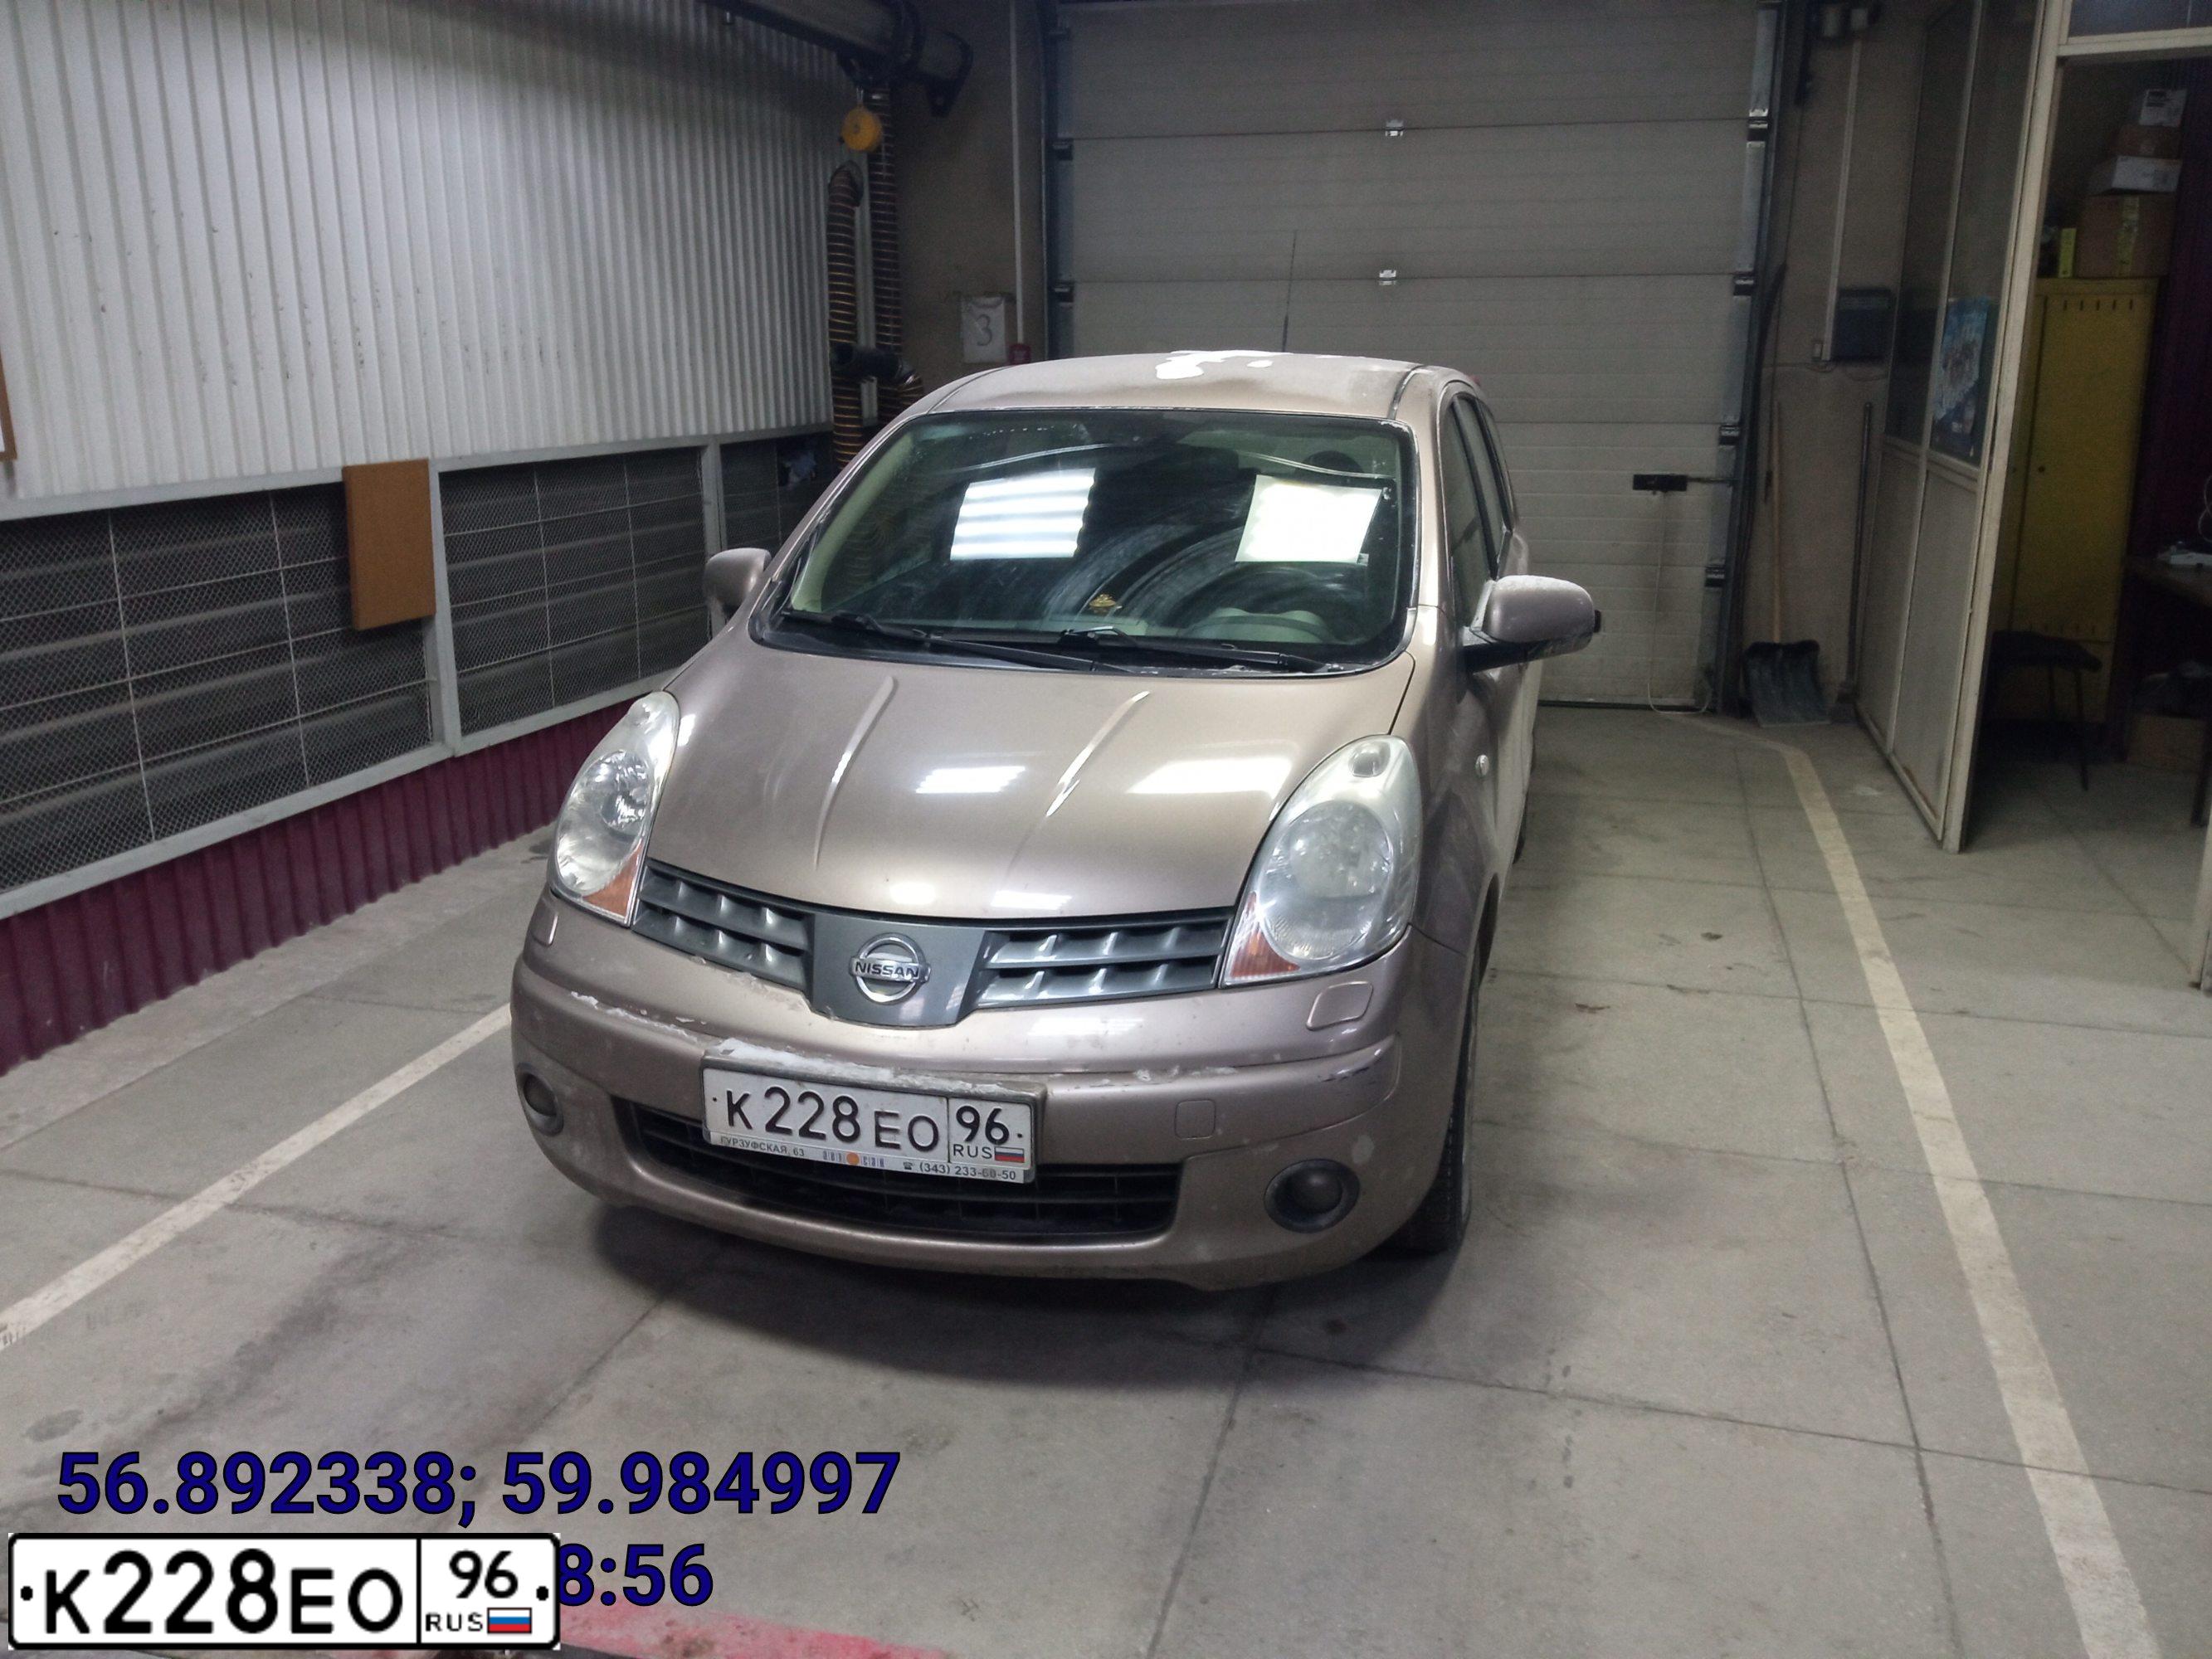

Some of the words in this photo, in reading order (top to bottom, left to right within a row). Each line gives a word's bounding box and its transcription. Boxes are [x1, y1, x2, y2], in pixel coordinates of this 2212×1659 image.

[976, 314, 993, 347] 3
[855, 961, 919, 979] NISSAN
[725, 1086, 939, 1153] К228ЕО
[955, 1105, 1010, 1146] 96
[792, 1147, 805, 1157] 63
[953, 1144, 993, 1160] RUS
[919, 1161, 951, 1175] (343)
